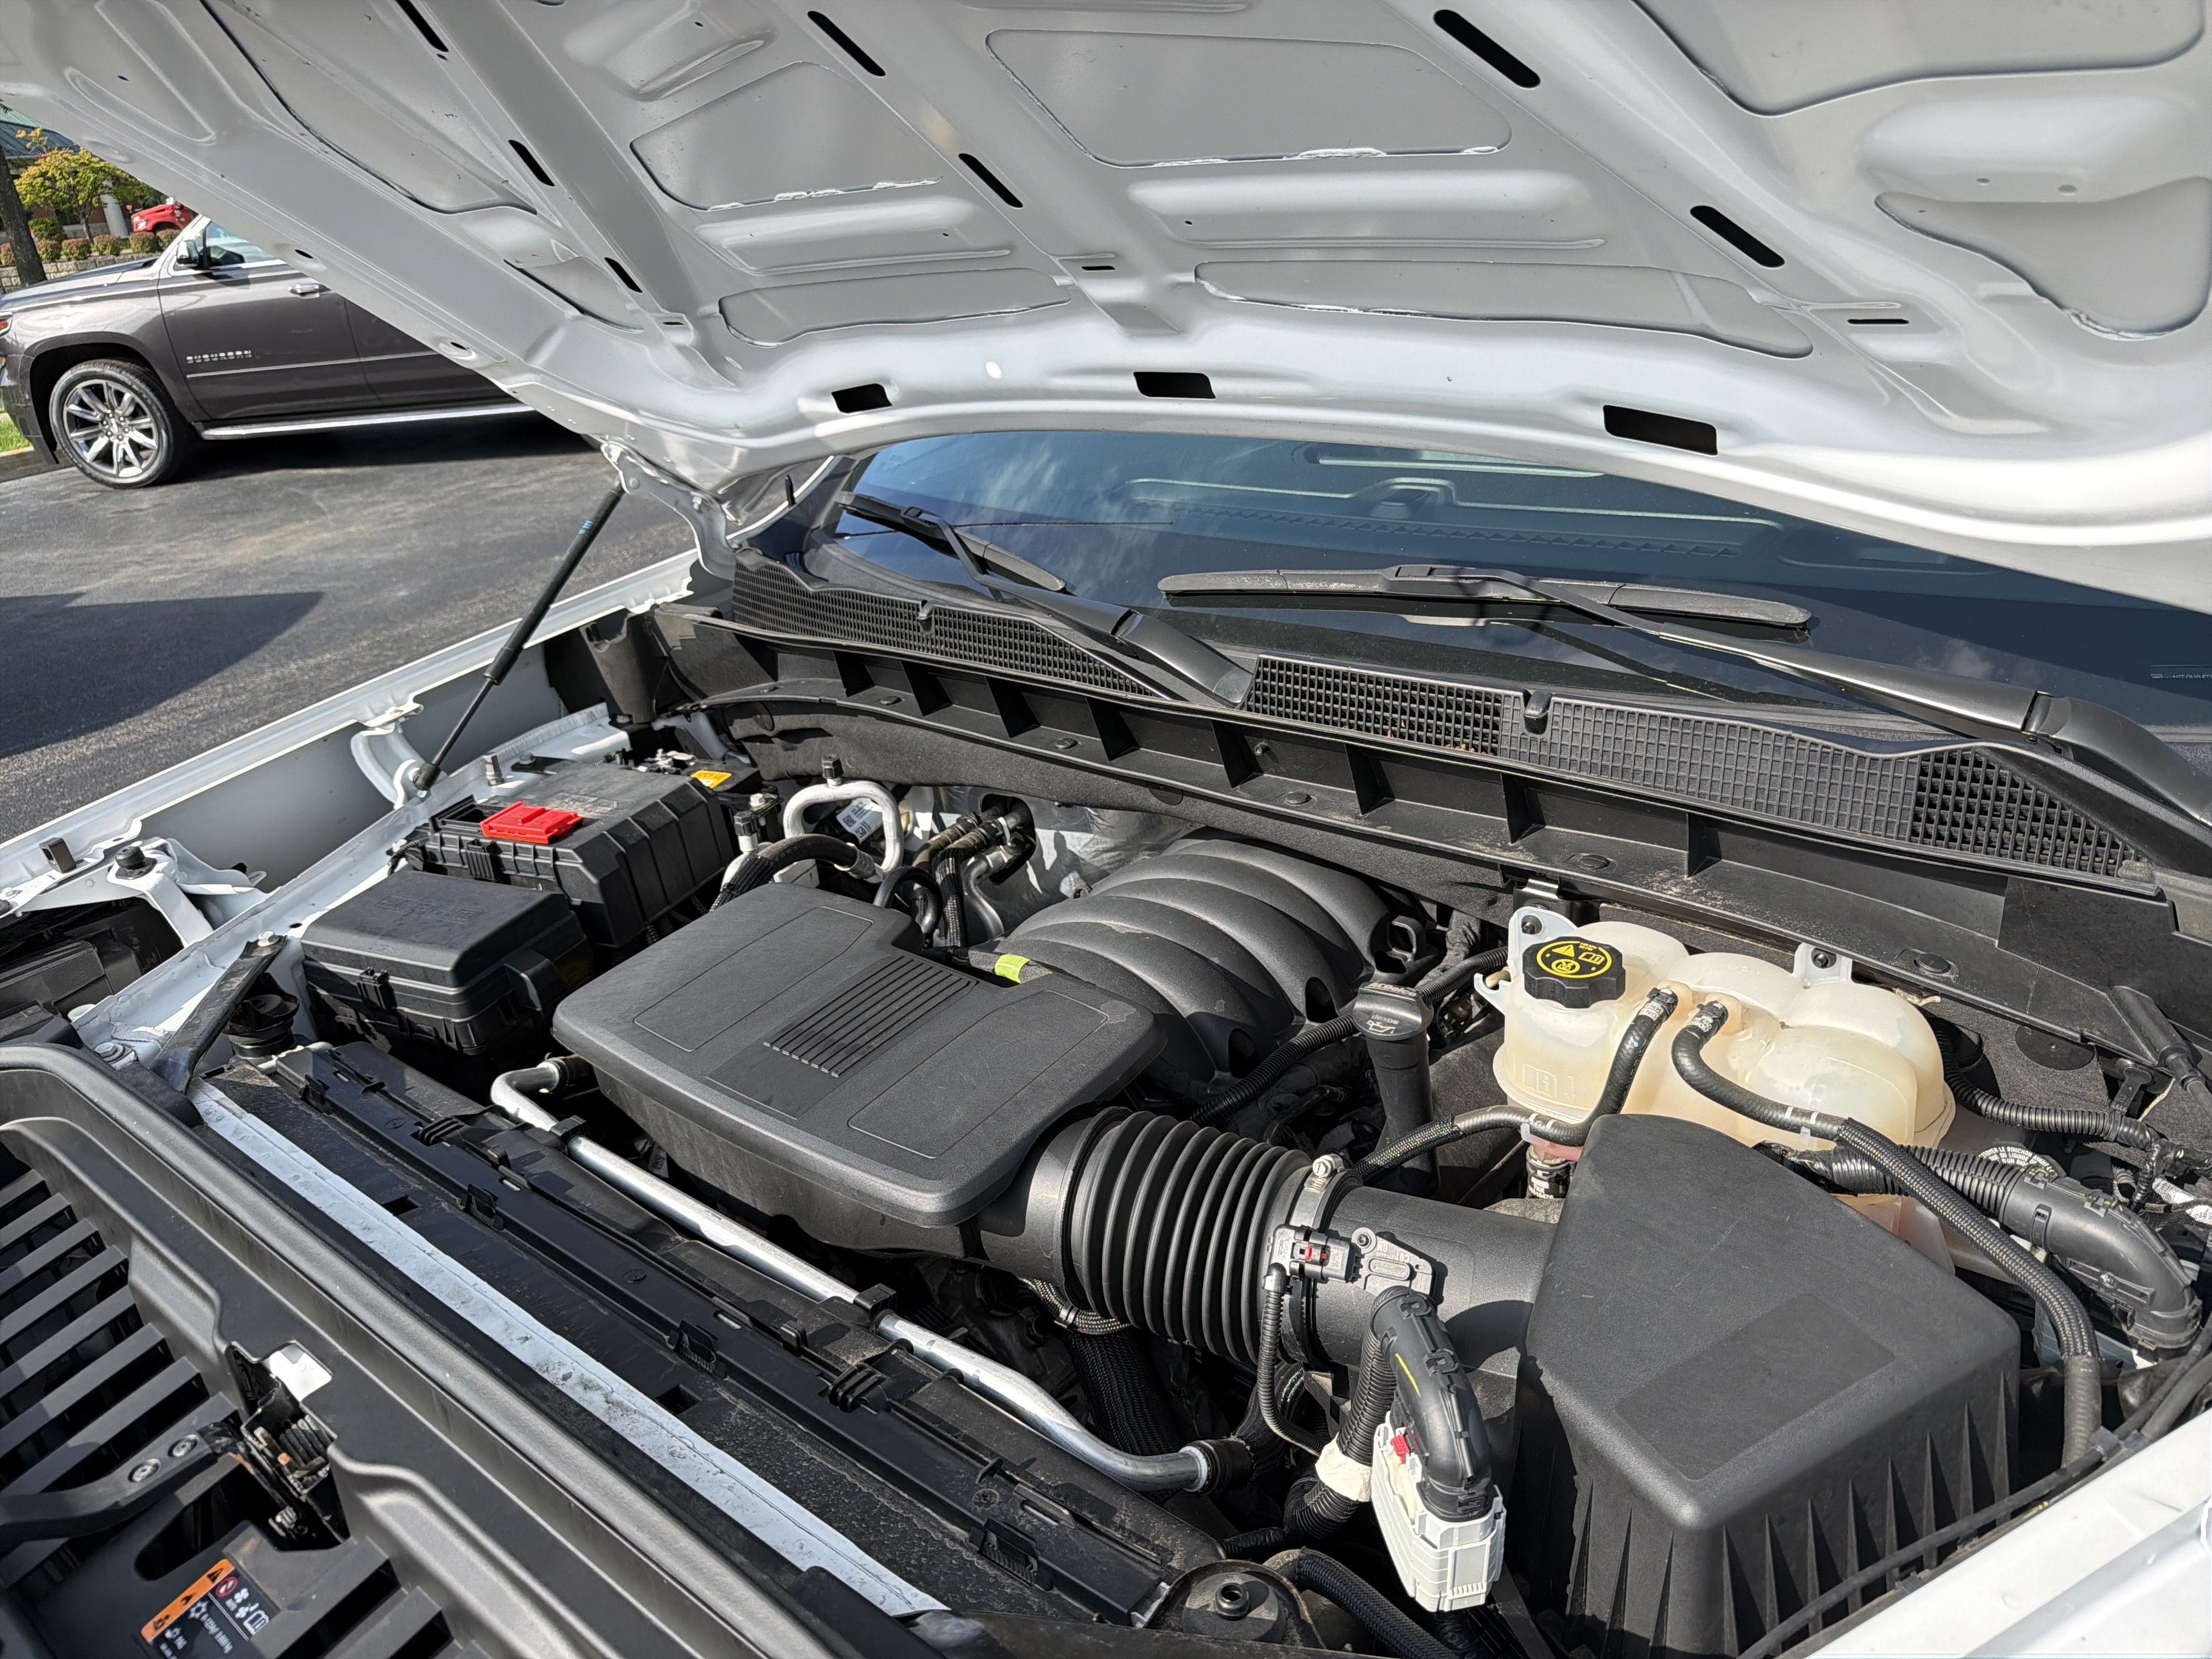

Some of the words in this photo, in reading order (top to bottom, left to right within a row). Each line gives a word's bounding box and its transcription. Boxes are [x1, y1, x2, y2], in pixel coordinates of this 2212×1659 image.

[187, 349, 252, 363] SUBURBAN
[1365, 982, 1417, 996] ACDelco
[1372, 1014, 1400, 1025] dexos
[2007, 1146, 2033, 1158] BOUCHON
[2032, 1154, 2050, 1167] AVANT
[2008, 1152, 2029, 1162] LIQUIDE
[1378, 1242, 1388, 1252] GM
